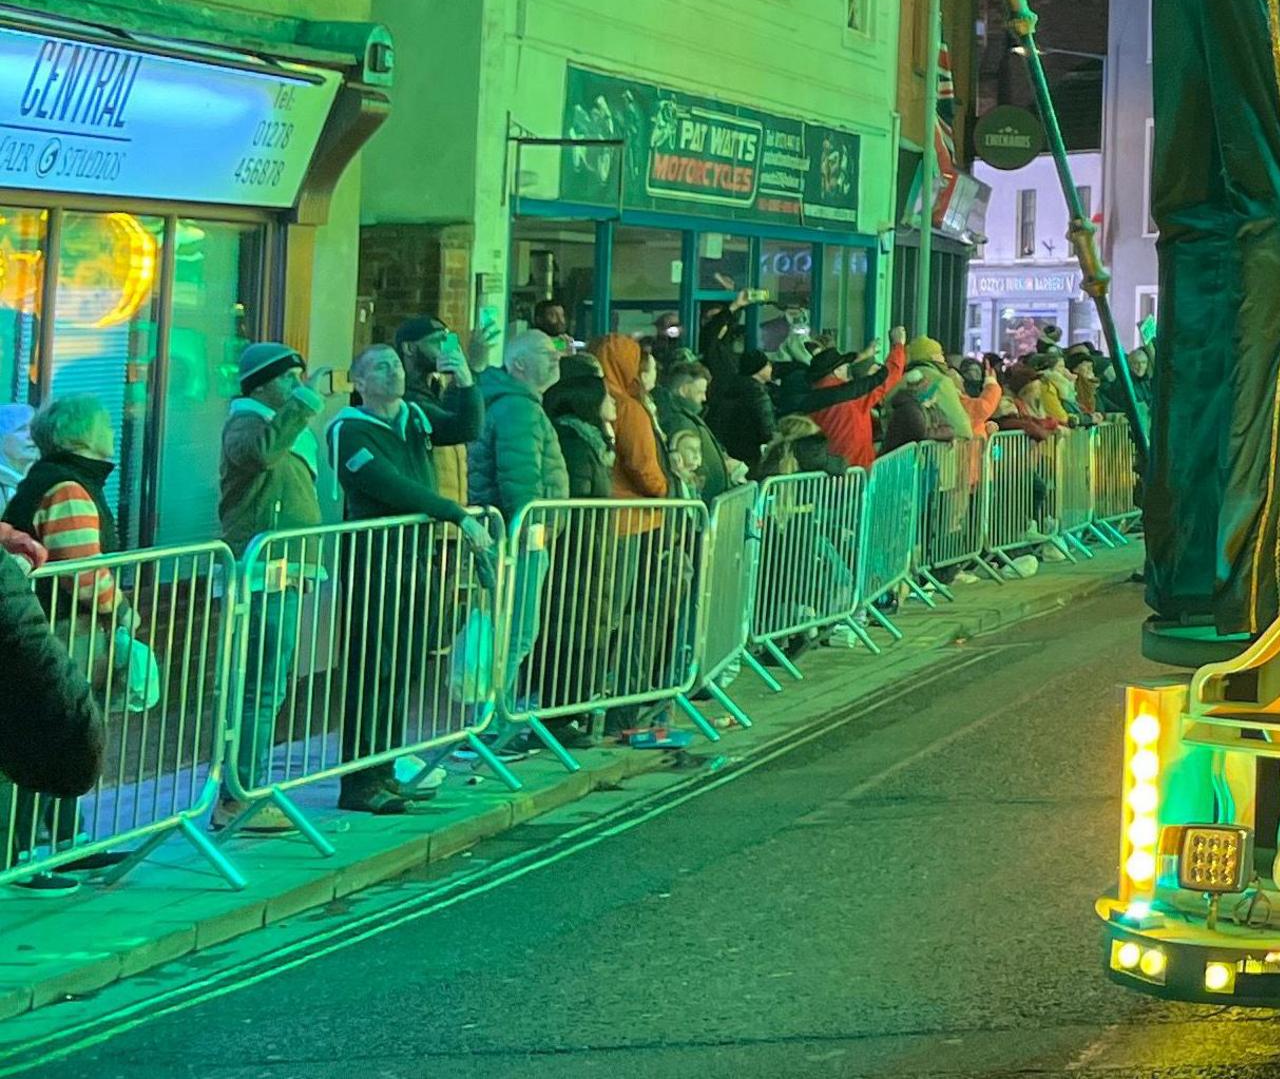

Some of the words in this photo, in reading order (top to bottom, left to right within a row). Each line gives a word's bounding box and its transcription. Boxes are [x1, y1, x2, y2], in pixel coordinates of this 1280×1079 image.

[20, 39, 144, 129] CENTRAL
[252, 119, 295, 151] 01278
[680, 120, 708, 153] PAT
[710, 126, 757, 162] WATTS
[234, 156, 286, 188] 456878
[652, 152, 753, 193] MOTORCYCLES
